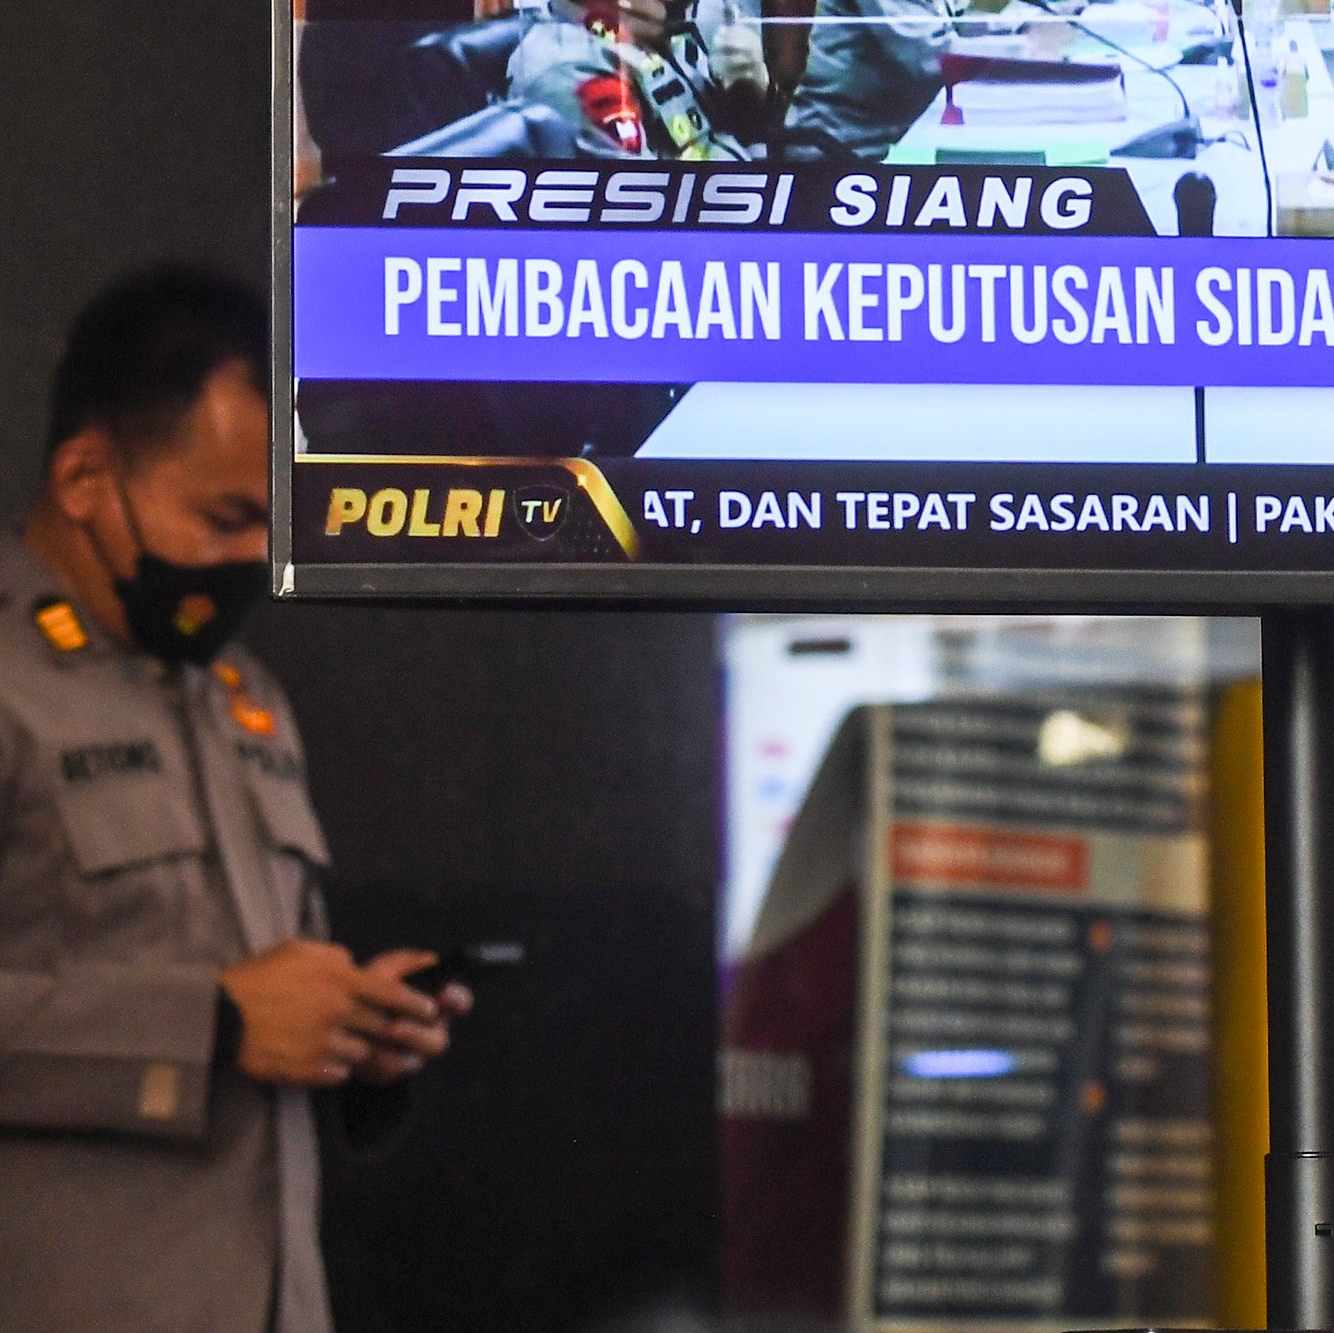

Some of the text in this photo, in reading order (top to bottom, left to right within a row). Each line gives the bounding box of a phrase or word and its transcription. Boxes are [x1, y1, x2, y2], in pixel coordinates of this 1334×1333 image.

[382, 168, 1094, 230] PRESISI SIANG
[383, 256, 781, 341] PEMBACAAN
[803, 262, 1176, 345] KEPUTUSAN
[324, 487, 562, 538] POLRI TV
[719, 491, 821, 529] DAN
[836, 492, 976, 530] TEPAT
[989, 493, 1209, 532] SASARAN
